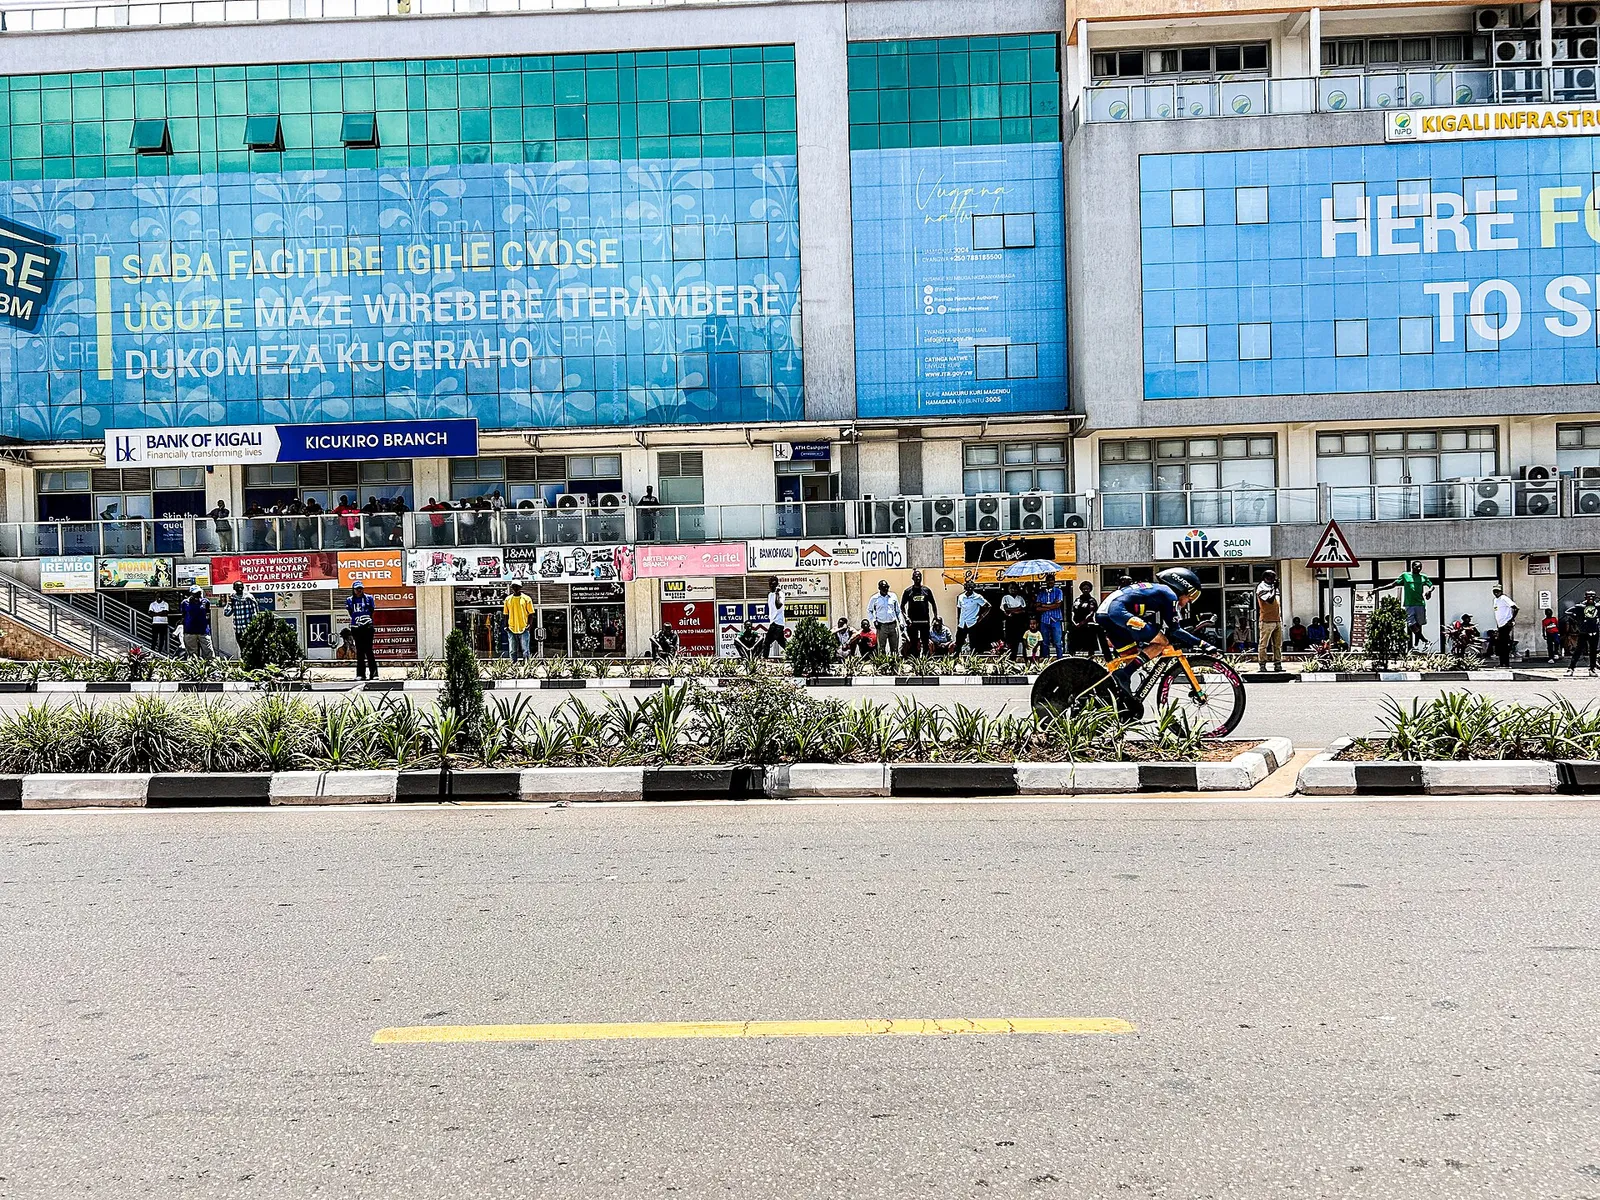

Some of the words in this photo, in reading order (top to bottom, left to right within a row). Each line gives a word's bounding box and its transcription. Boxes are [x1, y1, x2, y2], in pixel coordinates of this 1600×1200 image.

[1422, 112, 1491, 135] KIGALI
[1494, 107, 1600, 132] INFRASTR
[1320, 189, 1518, 259] HERE
[121, 252, 218, 285] SABA
[228, 245, 385, 281] FAGITIRE
[396, 239, 491, 275] IGIHE
[501, 237, 619, 272] CYOSE
[124, 297, 244, 334] UGUZE
[254, 294, 354, 329] MAZE
[363, 288, 544, 325] WIREBERE
[556, 284, 781, 319] ITERAMBERE
[1423, 278, 1522, 343] TO
[1544, 275, 1600, 338] S
[125, 343, 327, 381] DUKOMEZA
[338, 336, 533, 374] KUGERAHO
[146, 432, 189, 450] BANK
[191, 431, 214, 449] OF
[216, 430, 262, 448] KIGALI
[305, 433, 380, 451] KICUKIRO
[382, 431, 448, 448] BRANCH
[146, 449, 189, 460] Financially
[190, 448, 243, 460] transforming
[244, 447, 263, 458] lives
[163, 522, 184, 531] queu
[1223, 538, 1252, 548] SALON
[1172, 540, 1220, 558] NIK
[1223, 548, 1244, 557] KIDS
[239, 558, 269, 567] NOTERI
[269, 556, 310, 565] WIKORERA
[337, 559, 386, 569] MANGO
[386, 557, 402, 568] 4G
[713, 552, 741, 563] airtel
[799, 558, 833, 567] EQUITY
[41, 562, 92, 572] IREMBO
[118, 561, 153, 572] MOANA
[242, 565, 276, 574] PRIVATE
[276, 564, 308, 573] NOTARY
[247, 572, 278, 582] NOTAIRE
[278, 571, 304, 580] PRIVE
[347, 569, 392, 580] CENTER
[245, 584, 263, 592] Tel:
[264, 581, 318, 591] 0795926206
[780, 582, 804, 590] rembo
[373, 593, 401, 601] ANGO
[402, 592, 414, 600] 4G
[678, 616, 701, 626] airtel
[1139, 661, 1167, 699] cannondale
